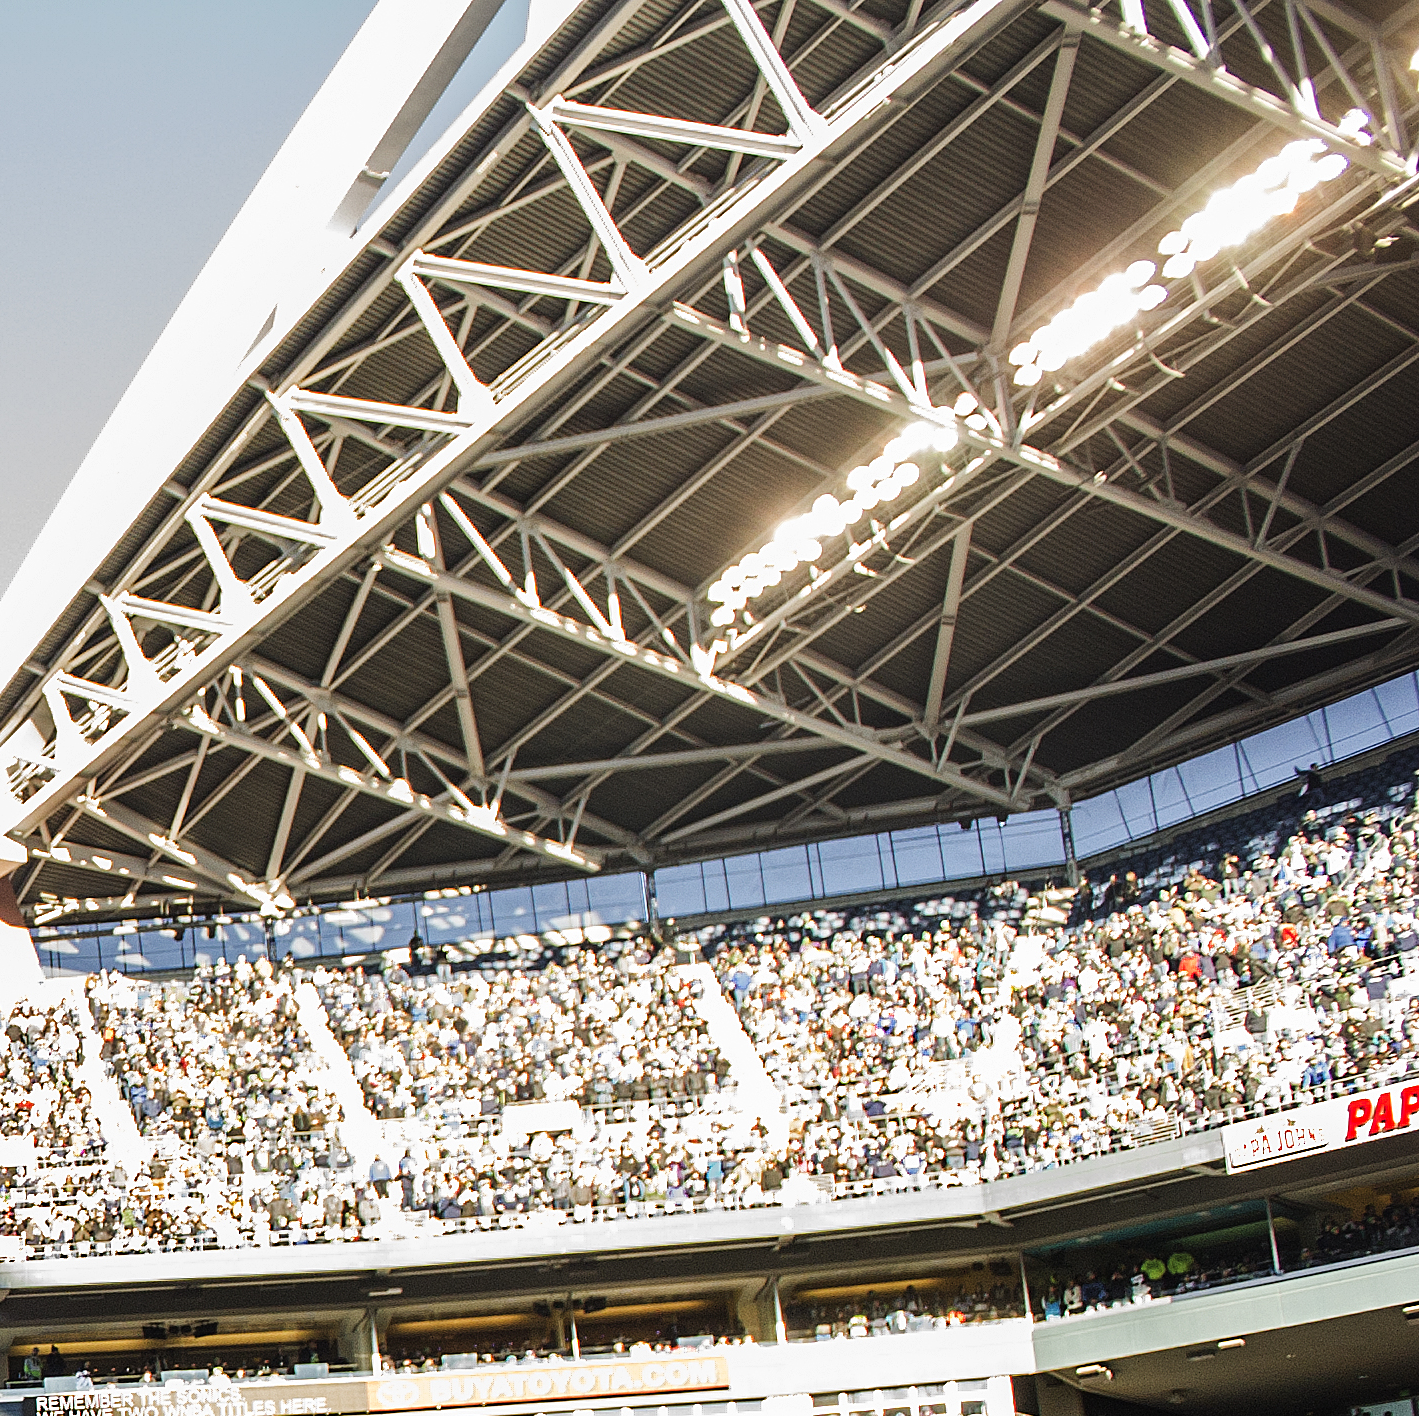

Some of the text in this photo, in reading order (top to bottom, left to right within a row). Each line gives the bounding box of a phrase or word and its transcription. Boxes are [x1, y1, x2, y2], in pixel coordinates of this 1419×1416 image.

[429, 1359, 718, 1403] BUYATOYOTA.COM
[35, 1392, 134, 1412] REMEMBER
[136, 1388, 172, 1407] THE
[219, 1399, 275, 1416] TITLES
